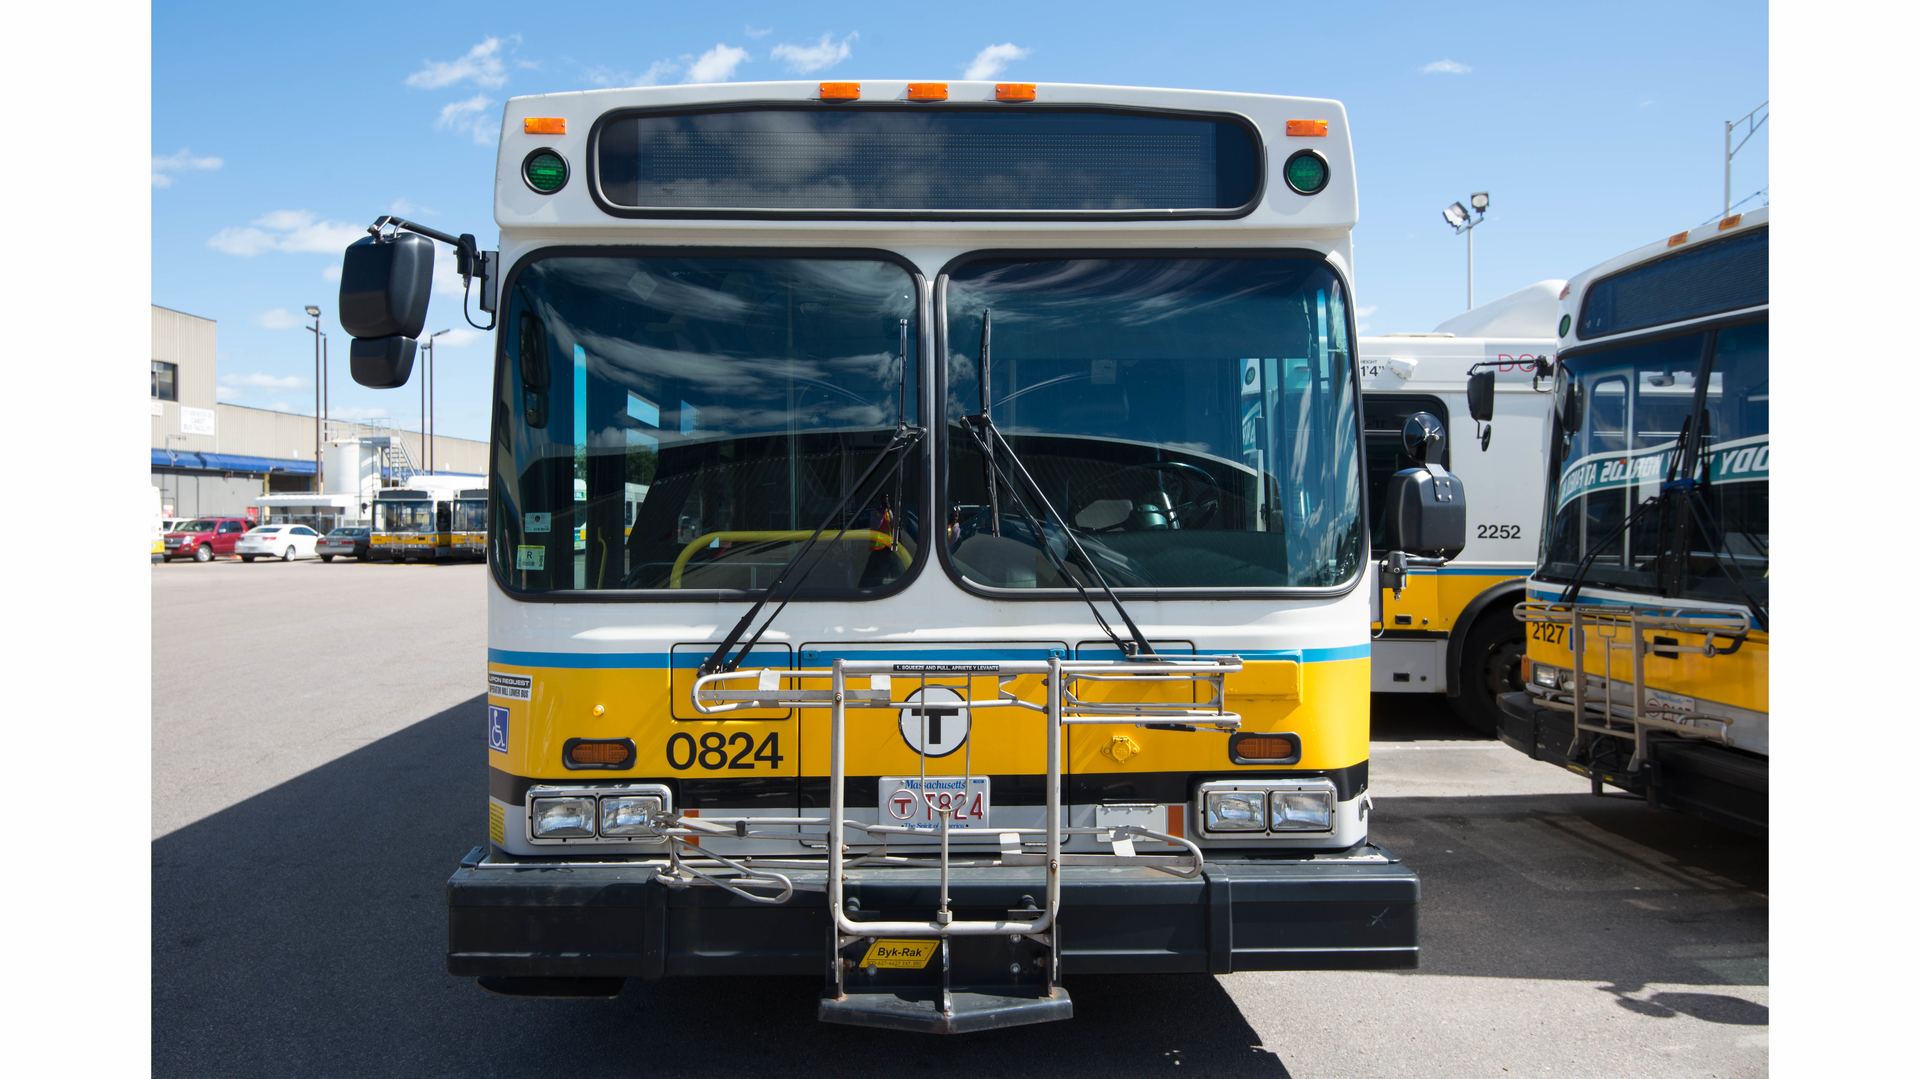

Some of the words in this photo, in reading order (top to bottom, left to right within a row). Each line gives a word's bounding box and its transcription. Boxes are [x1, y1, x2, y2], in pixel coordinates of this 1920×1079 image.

[1477, 524, 1521, 539] 2252
[527, 551, 533, 559] R
[1532, 621, 1565, 645] 2127
[489, 675, 502, 684] UPON
[502, 678, 530, 687] REQUEST
[509, 687, 520, 698] LOWER
[521, 689, 529, 699] BUS
[911, 707, 959, 745] T
[666, 731, 784, 771] 0824
[924, 791, 984, 821] T824
[877, 947, 922, 958] Byk-Rak
